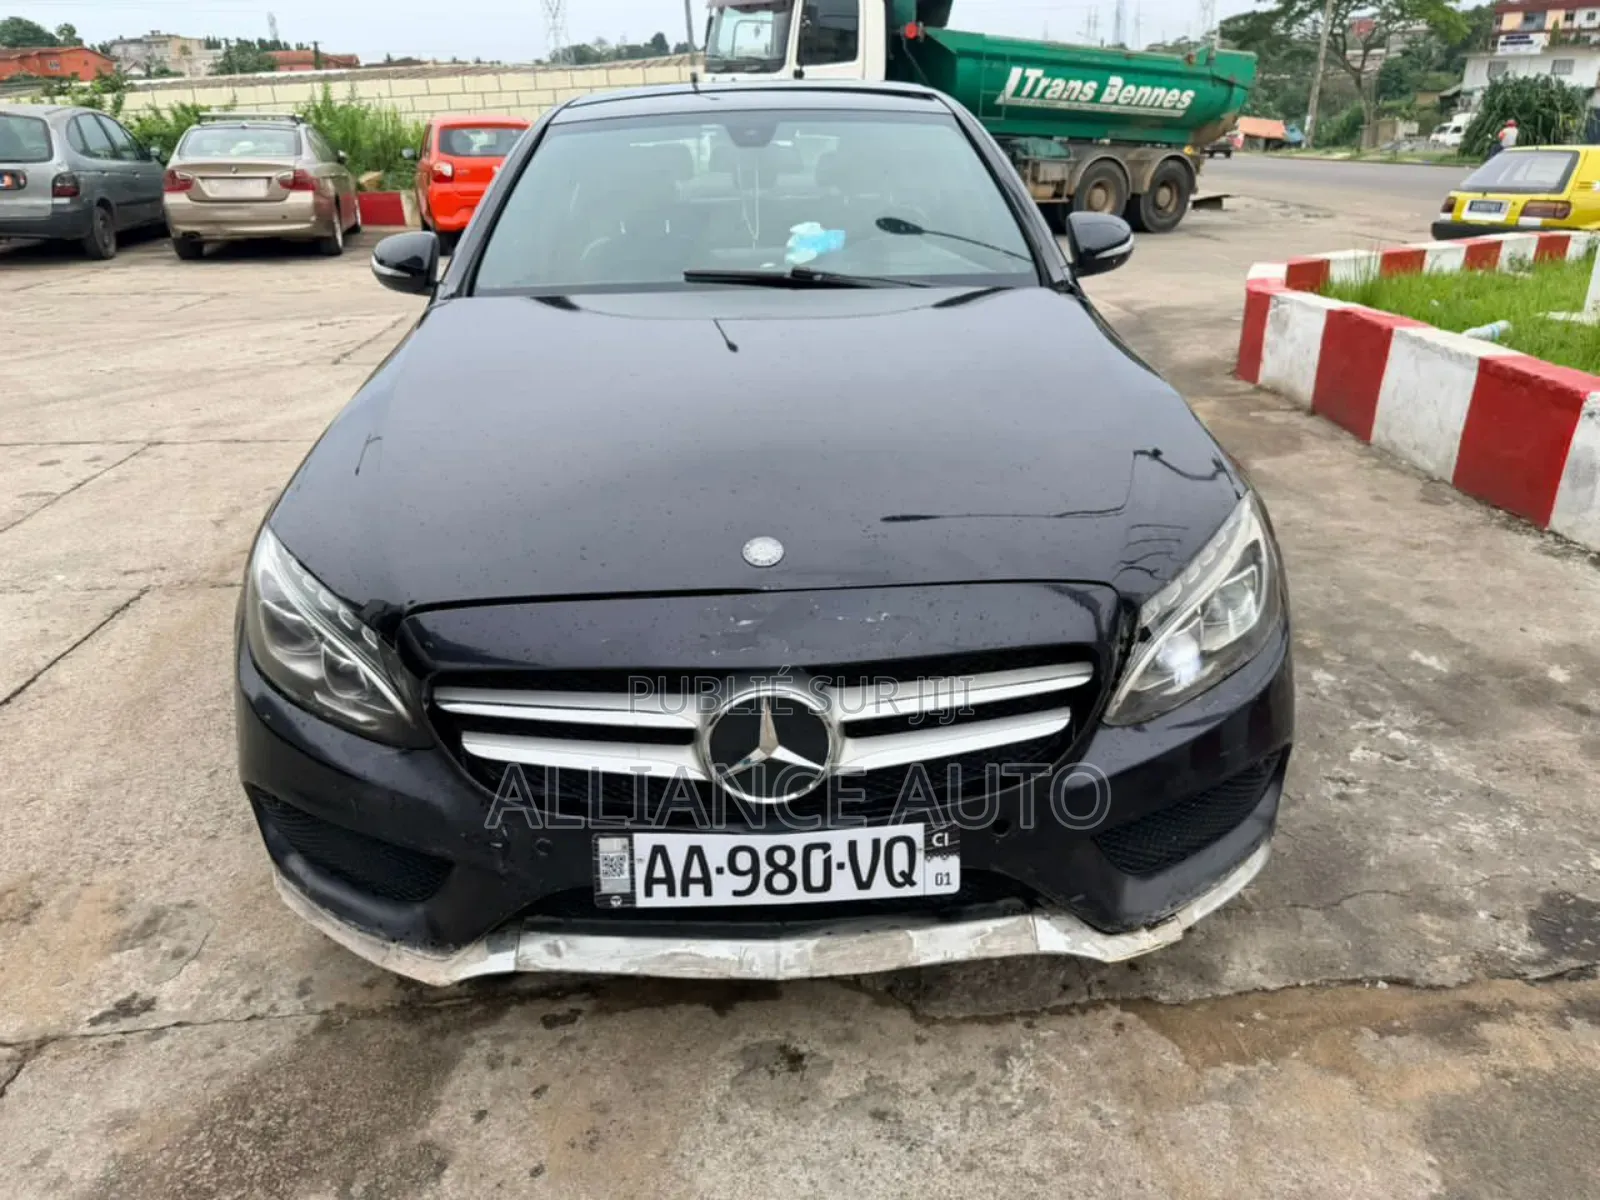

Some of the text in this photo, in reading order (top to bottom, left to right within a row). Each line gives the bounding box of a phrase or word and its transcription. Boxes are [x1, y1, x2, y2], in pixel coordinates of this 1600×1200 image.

[1100, 75, 1195, 109] Bennes
[931, 832, 949, 847] CI
[934, 872, 952, 887] 01
